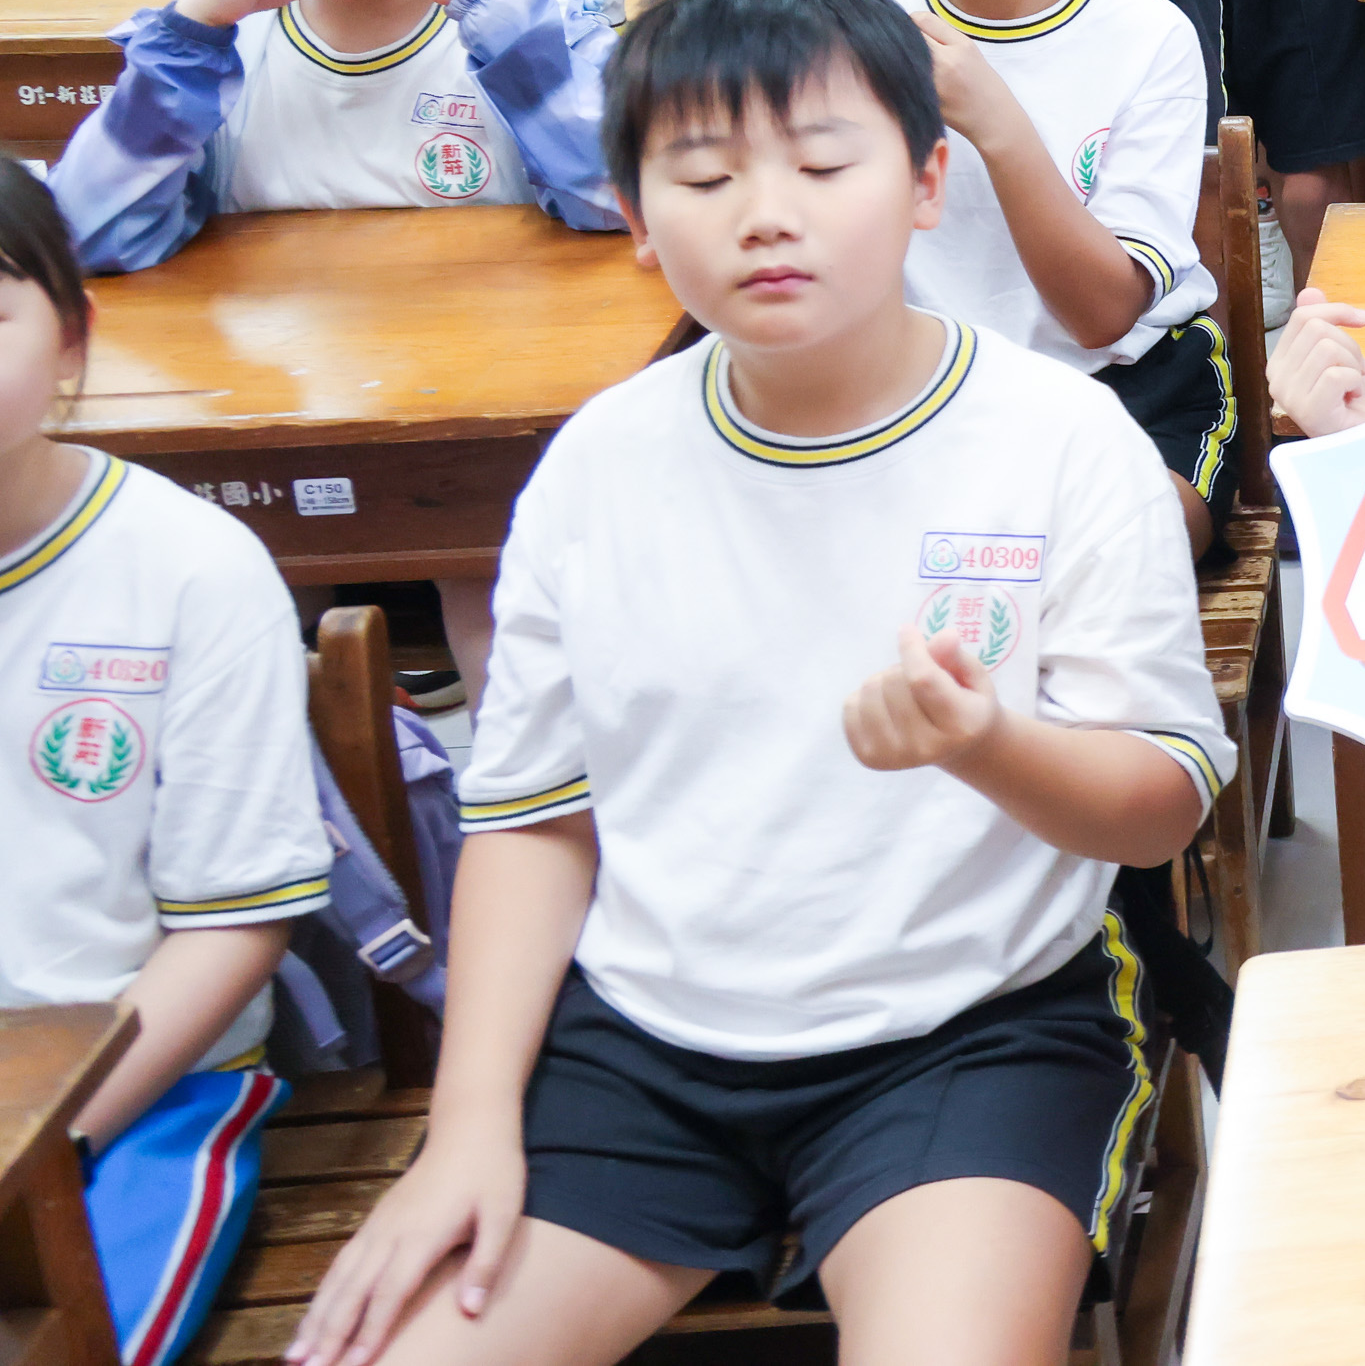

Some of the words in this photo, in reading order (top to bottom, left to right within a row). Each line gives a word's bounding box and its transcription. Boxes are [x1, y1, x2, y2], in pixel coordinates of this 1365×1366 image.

[441, 144, 464, 175] 新莊
[304, 483, 343, 495] C150
[961, 546, 1040, 571] 40309
[955, 596, 985, 644] 新莊
